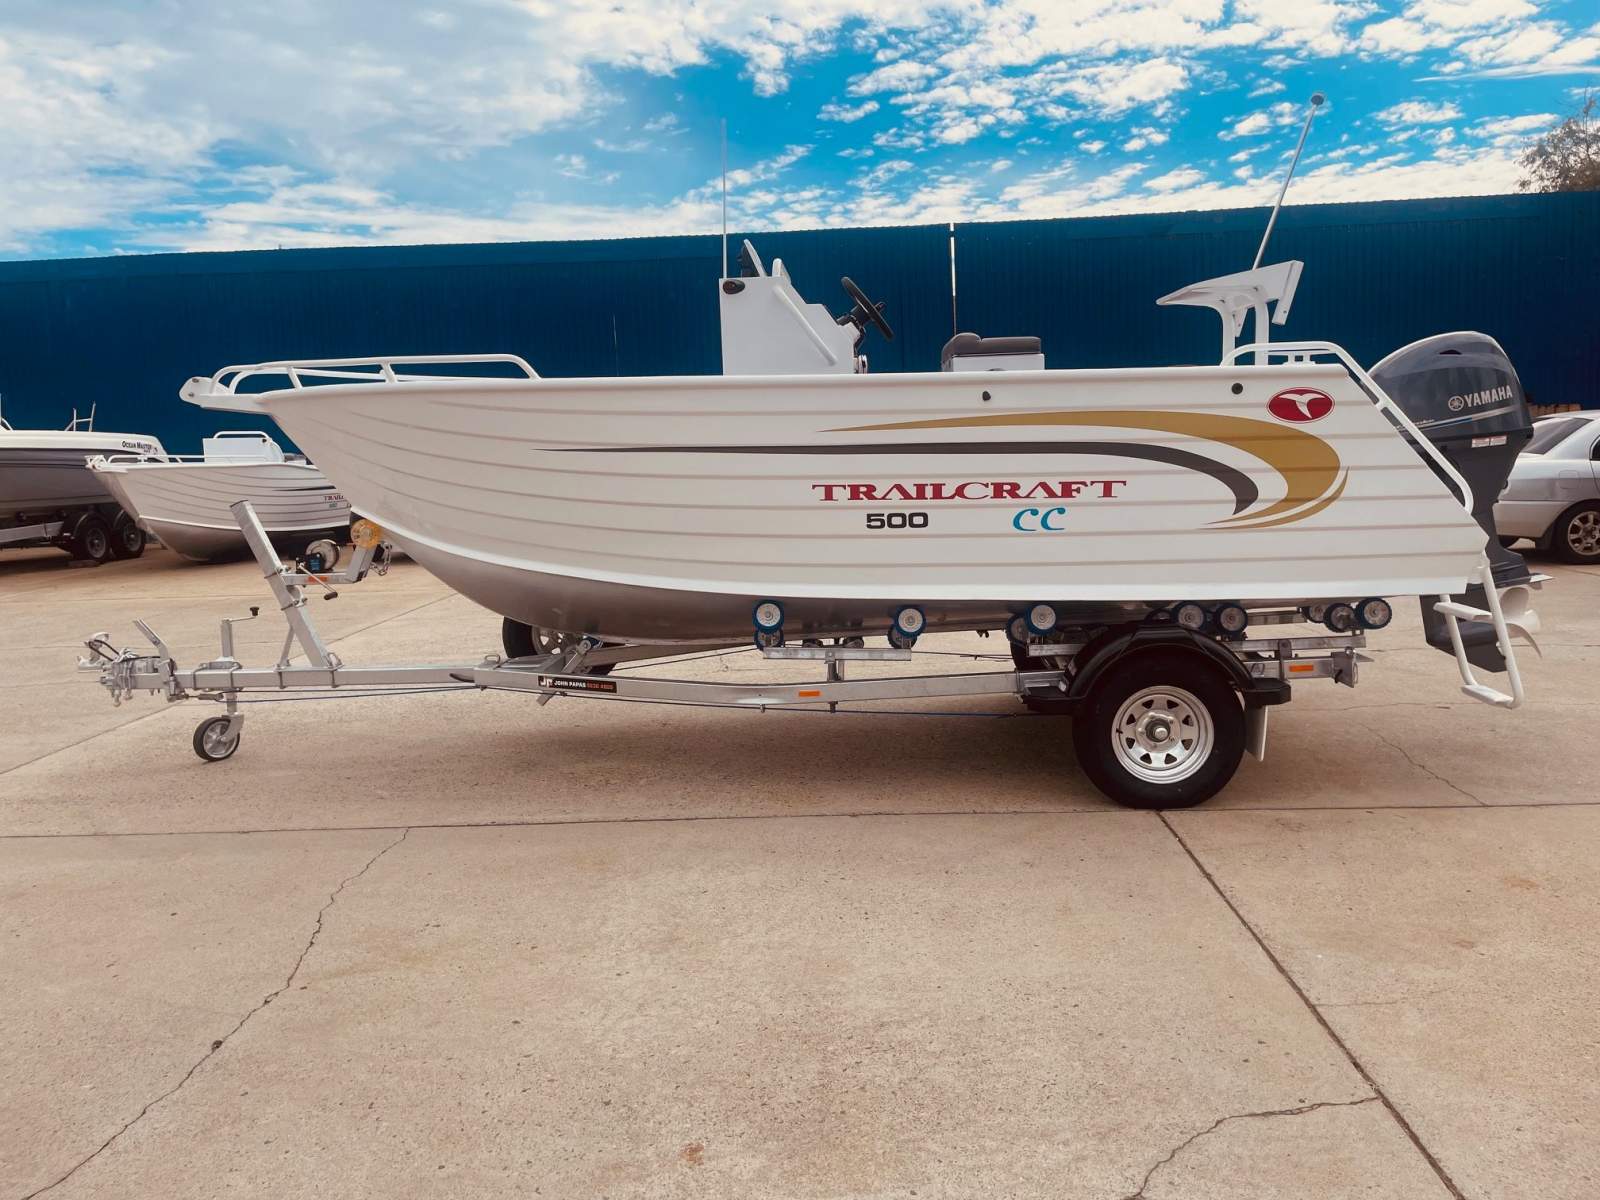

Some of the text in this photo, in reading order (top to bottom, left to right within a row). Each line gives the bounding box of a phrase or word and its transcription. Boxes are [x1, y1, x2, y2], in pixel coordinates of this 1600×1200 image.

[1464, 385, 1513, 408] YAMAHA
[812, 480, 1127, 501] TRAILCRAFT
[866, 512, 929, 529] 500
